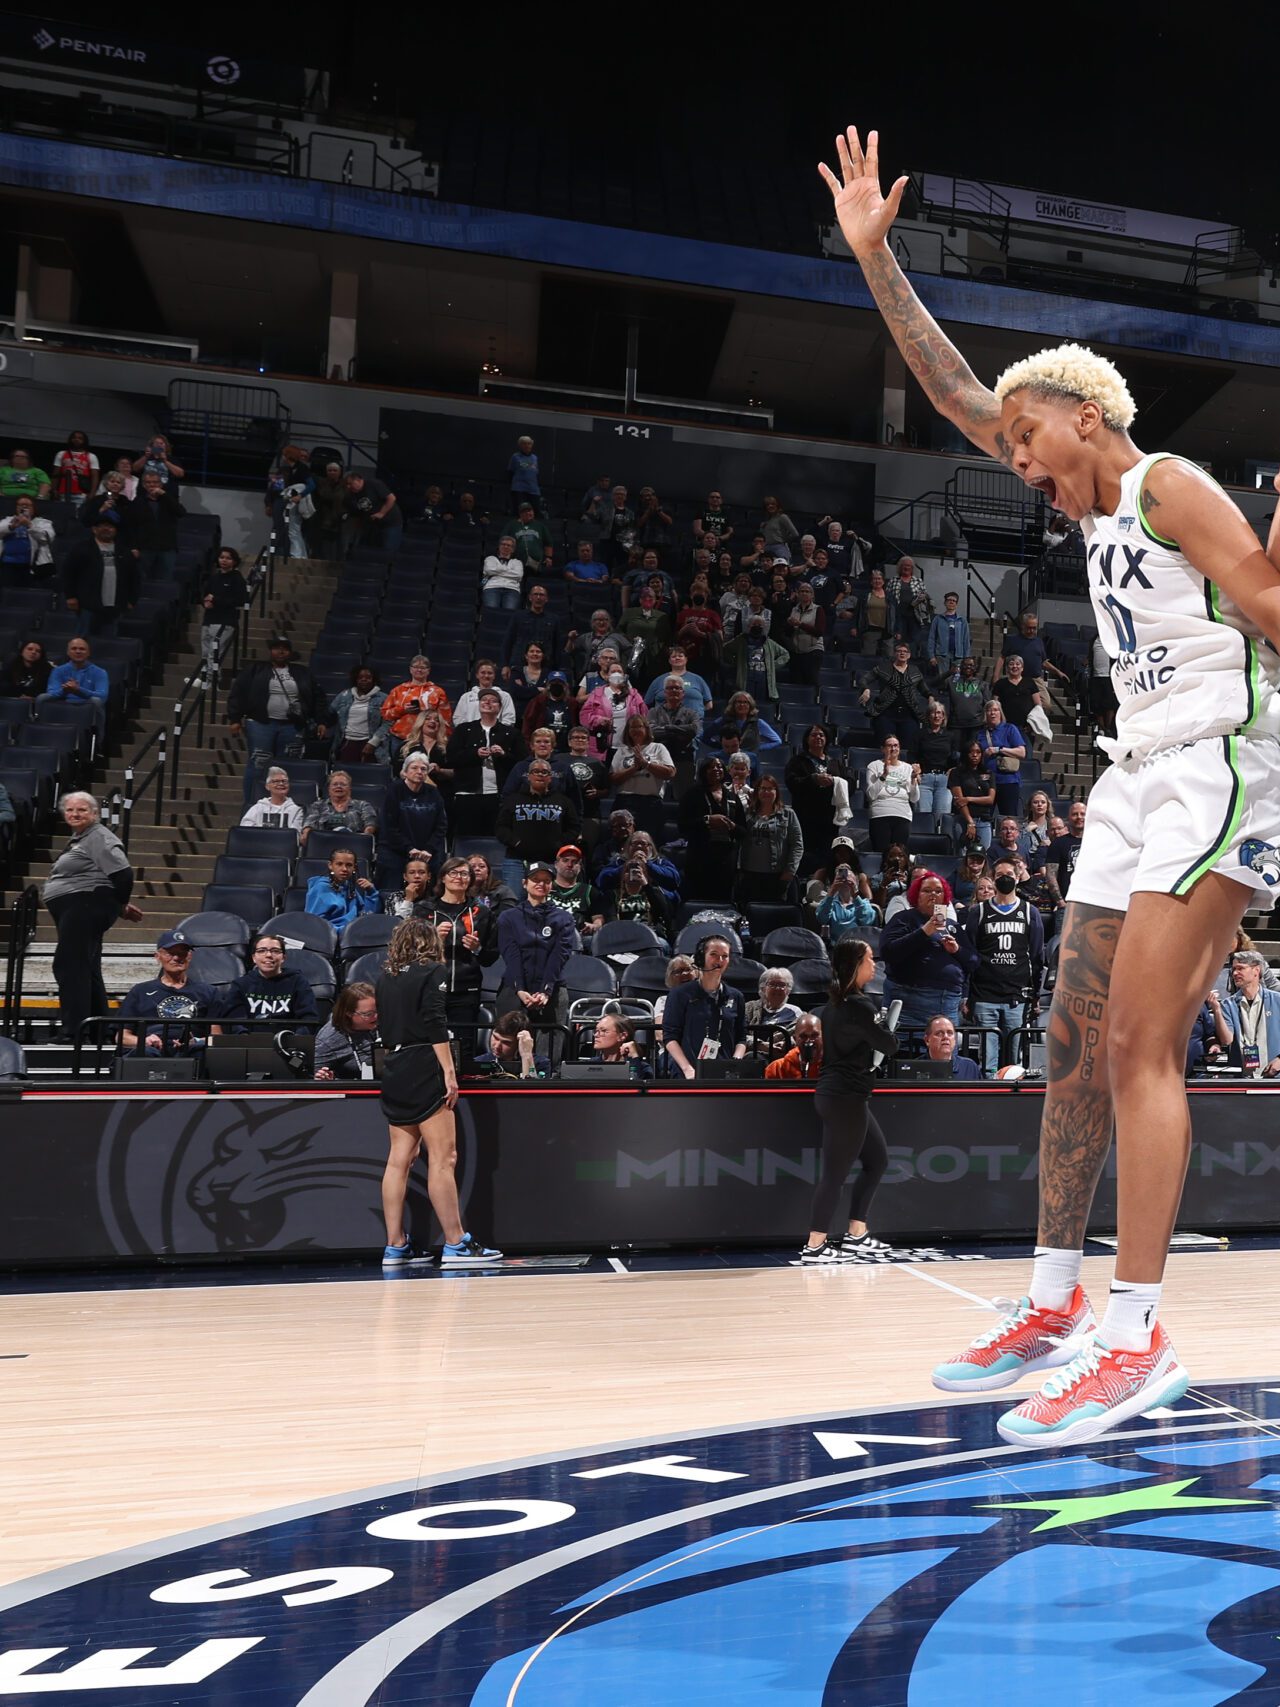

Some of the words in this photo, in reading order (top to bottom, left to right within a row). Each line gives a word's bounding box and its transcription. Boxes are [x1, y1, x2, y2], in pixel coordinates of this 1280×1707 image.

[59, 37, 147, 63] PENTAIR
[515, 807, 562, 822] LYNX
[620, 901, 647, 912] LYN
[986, 921, 1024, 934] MINN
[997, 934, 1012, 950] 10
[990, 957, 1017, 965] CLINIC
[247, 997, 292, 1014] YNX
[615, 1144, 1043, 1188] MINNSOT
